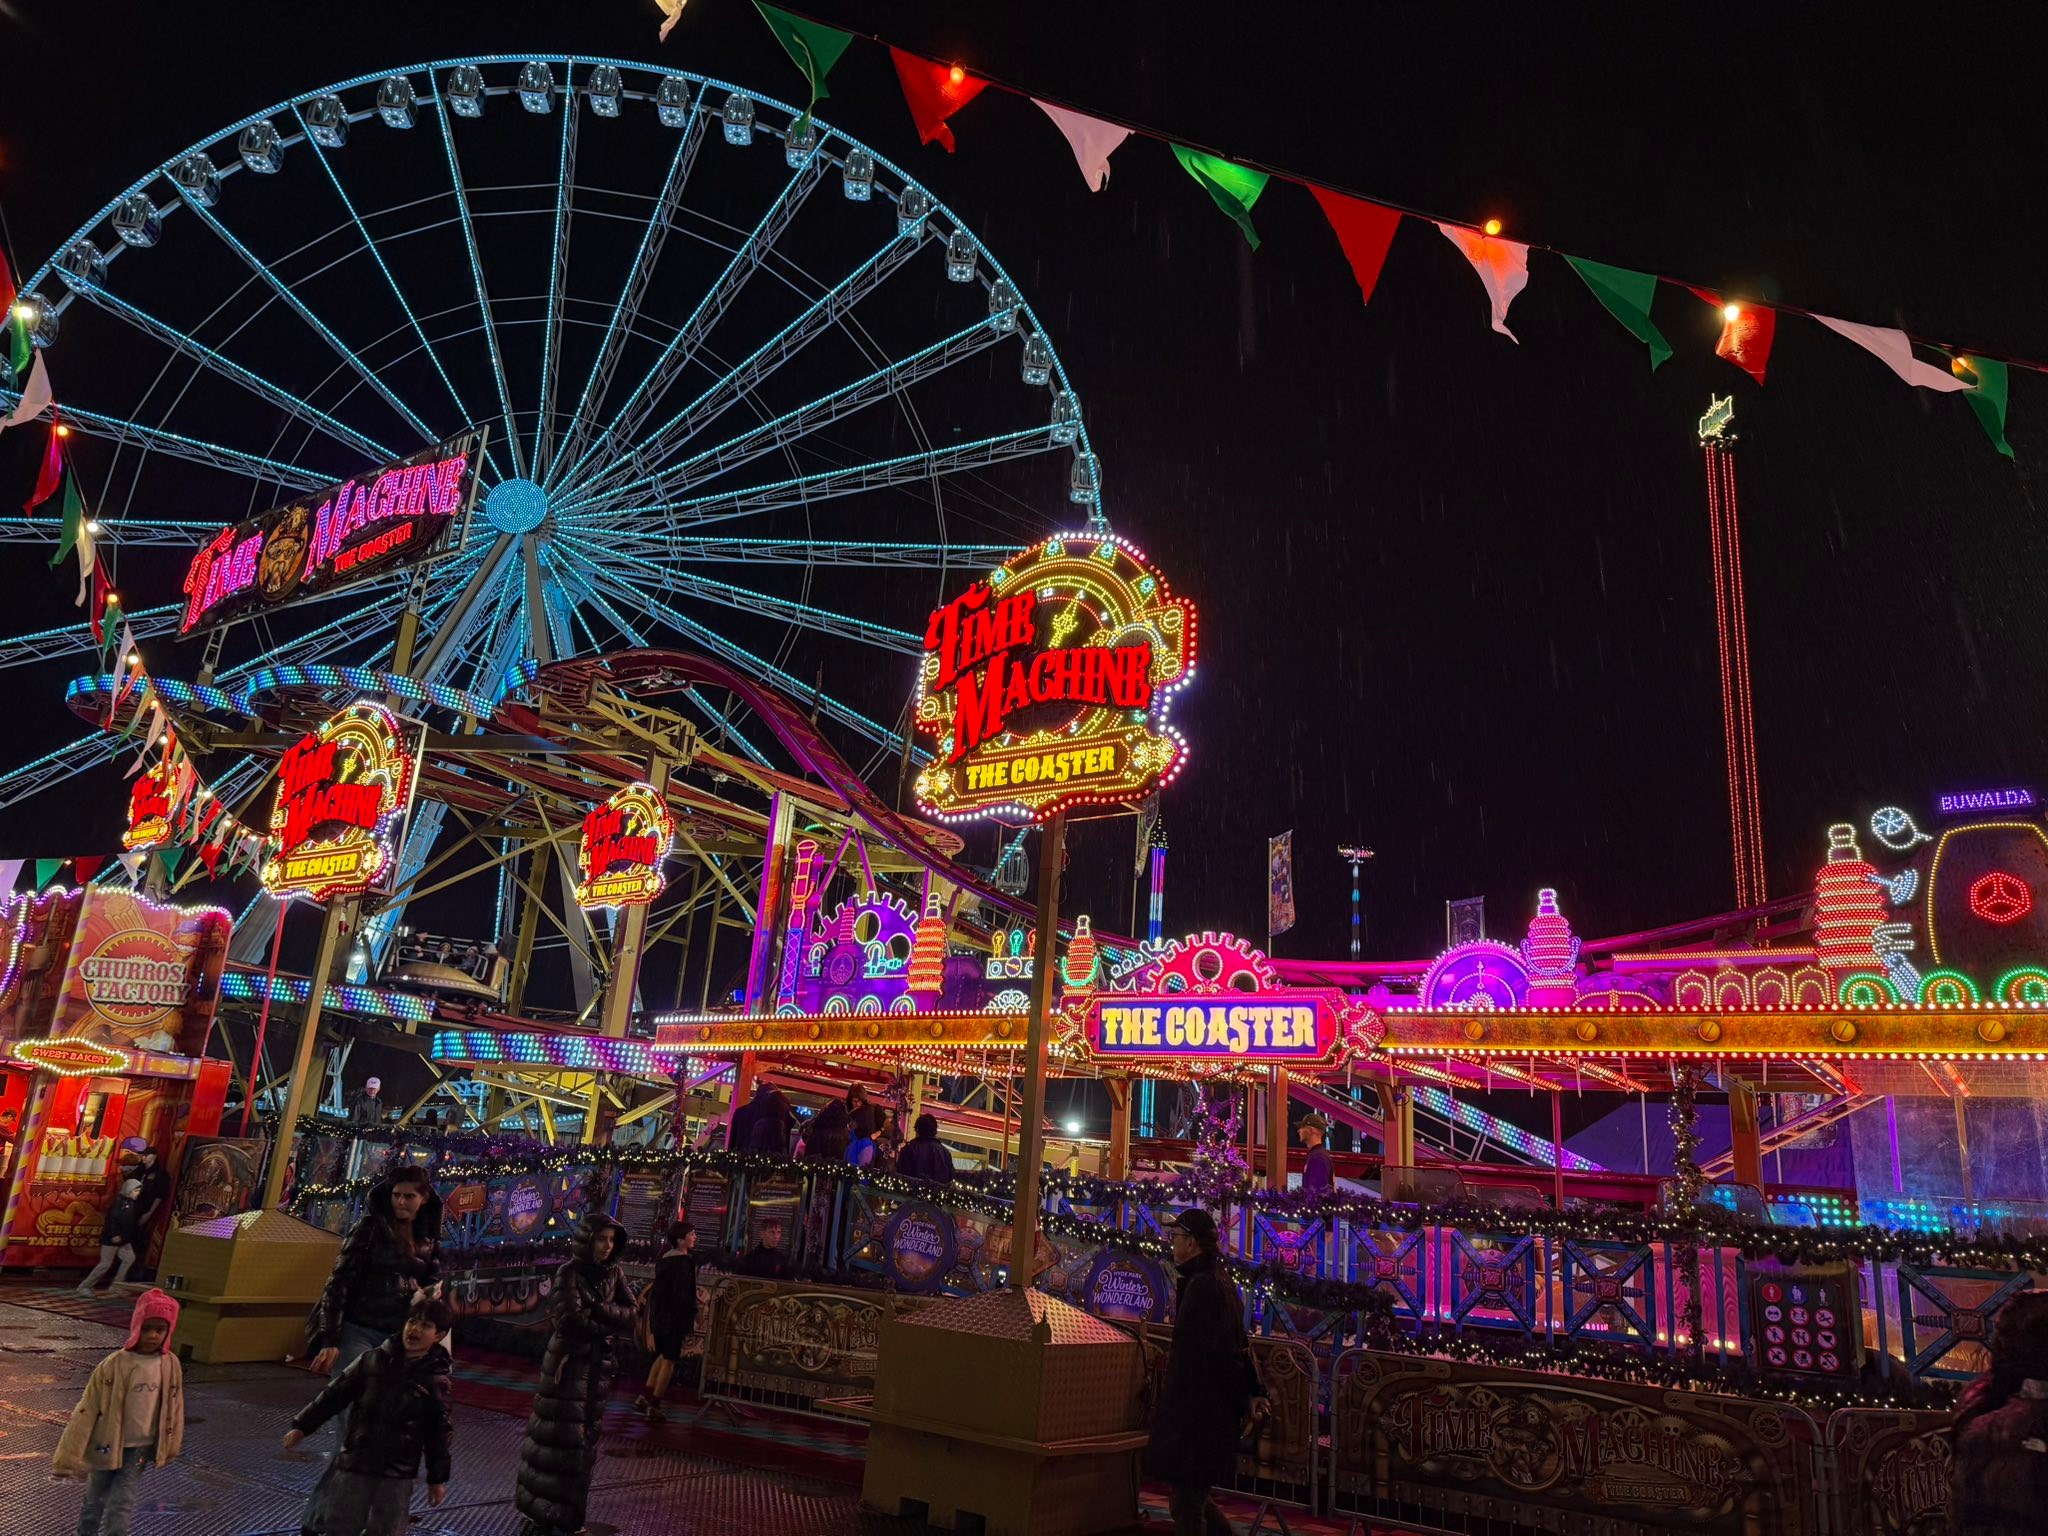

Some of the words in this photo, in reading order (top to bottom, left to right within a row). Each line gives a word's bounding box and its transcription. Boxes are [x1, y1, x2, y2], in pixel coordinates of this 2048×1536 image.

[183, 527, 264, 633] TIME
[301, 452, 468, 583] MACHINE
[333, 546, 357, 574] THE
[357, 522, 414, 562] COASTER
[924, 582, 1036, 691] TIME
[949, 640, 1151, 764] MACHINE
[966, 763, 1008, 790] THE
[1011, 746, 1116, 783] COASTER
[1941, 788, 2032, 811] BUWALDA
[277, 783, 383, 860] MACHINE
[286, 860, 308, 879] THE
[307, 853, 358, 877] COASTER
[592, 884, 608, 897] THE
[607, 880, 642, 896] COASTER
[82, 957, 185, 984] CHURROS
[94, 981, 190, 1002] FACTORY
[1101, 1007, 1162, 1045] THE
[1165, 1006, 1316, 1054] COASTER
[32, 1047, 70, 1061] SWEET
[71, 1051, 113, 1065] BAKERY
[28, 1237, 69, 1247] TASTE
[46, 1225, 71, 1234] THE
[900, 1218, 941, 1245] Winter
[894, 1239, 944, 1258] WONDERLAND
[1099, 1269, 1149, 1295] Winter
[1128, 1272, 1143, 1280] PARK
[1093, 1292, 1154, 1310] WONDERLAND
[1391, 1386, 1495, 1464] TIME
[1559, 1414, 1726, 1491] MACHINE
